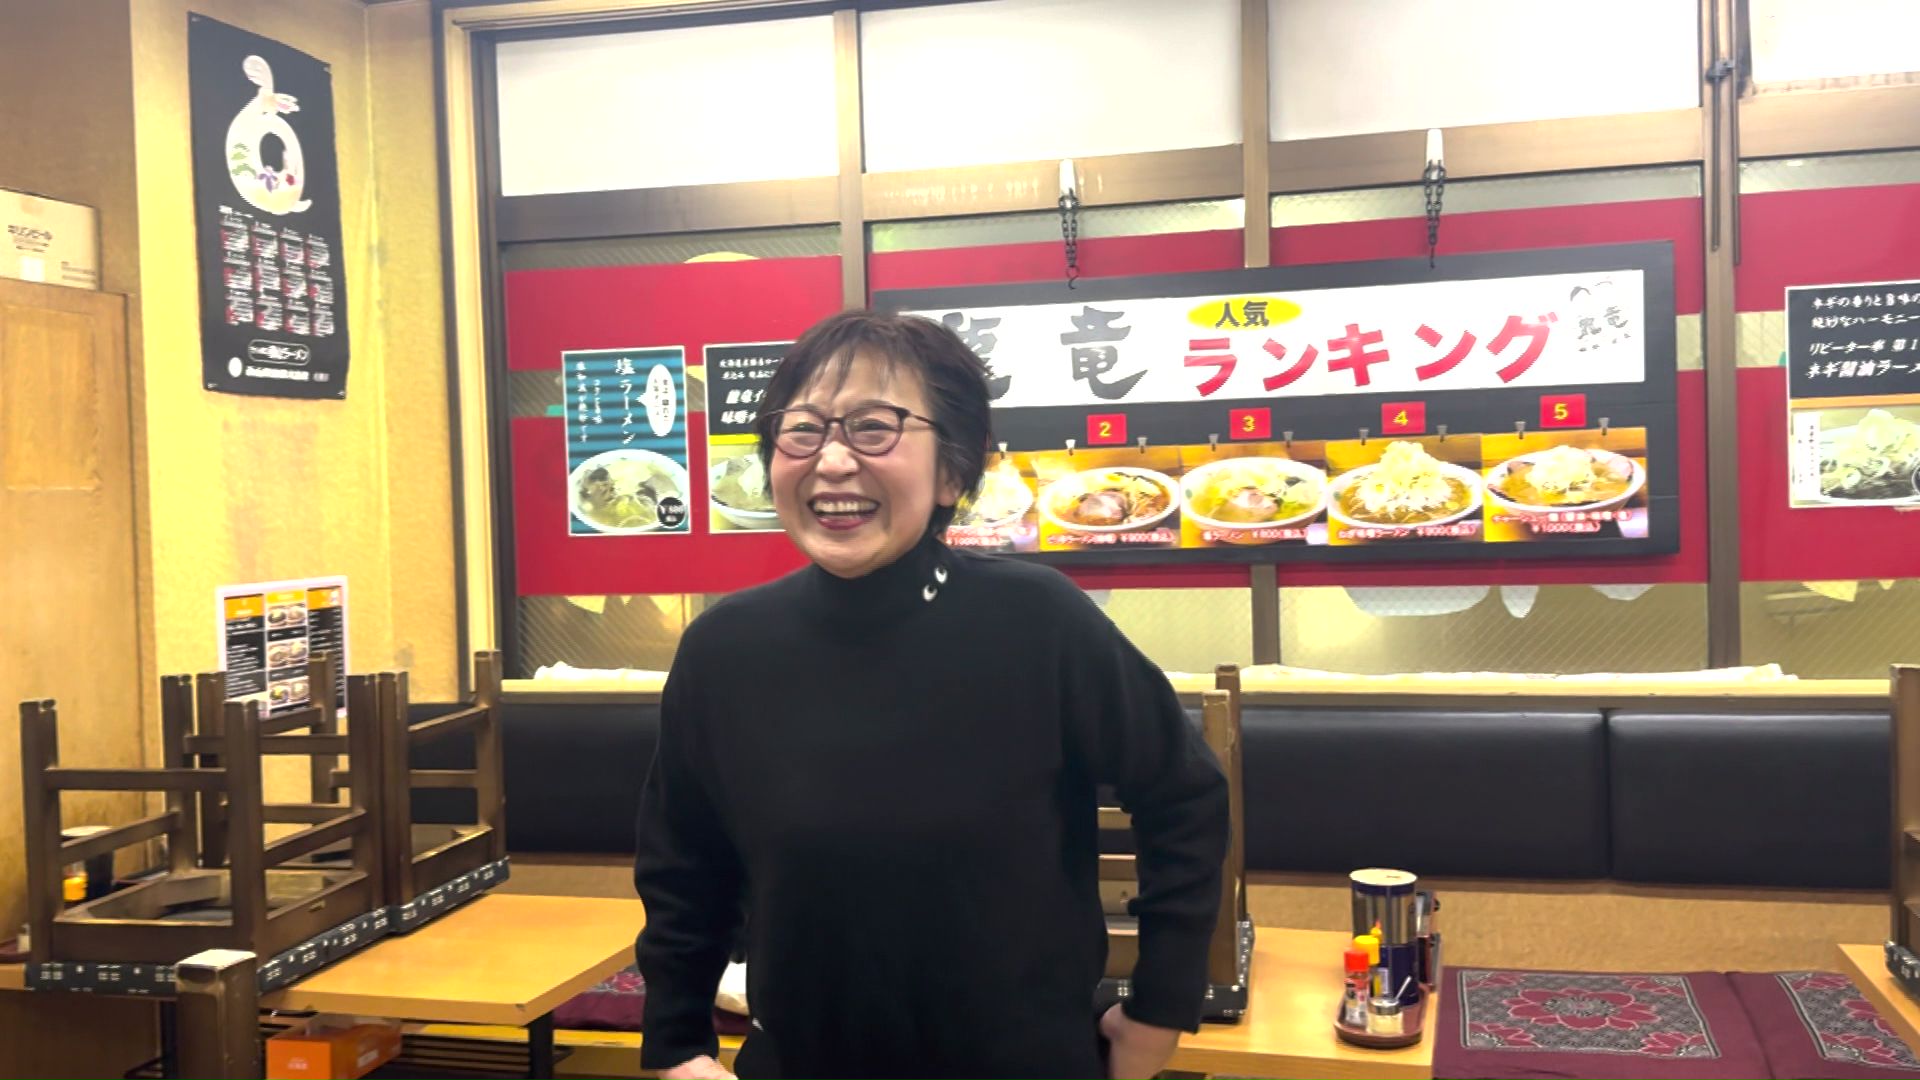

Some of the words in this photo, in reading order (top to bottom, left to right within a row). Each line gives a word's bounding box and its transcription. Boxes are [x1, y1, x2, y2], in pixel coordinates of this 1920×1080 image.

[1215, 300, 1269, 328] 人気
[1184, 312, 1559, 397] ランキング
[615, 357, 635, 444] 塩ラーメン
[1393, 410, 1408, 426] 4
[1555, 403, 1569, 420] 5
[1099, 422, 1111, 437] 2
[1243, 415, 1256, 432] 3
